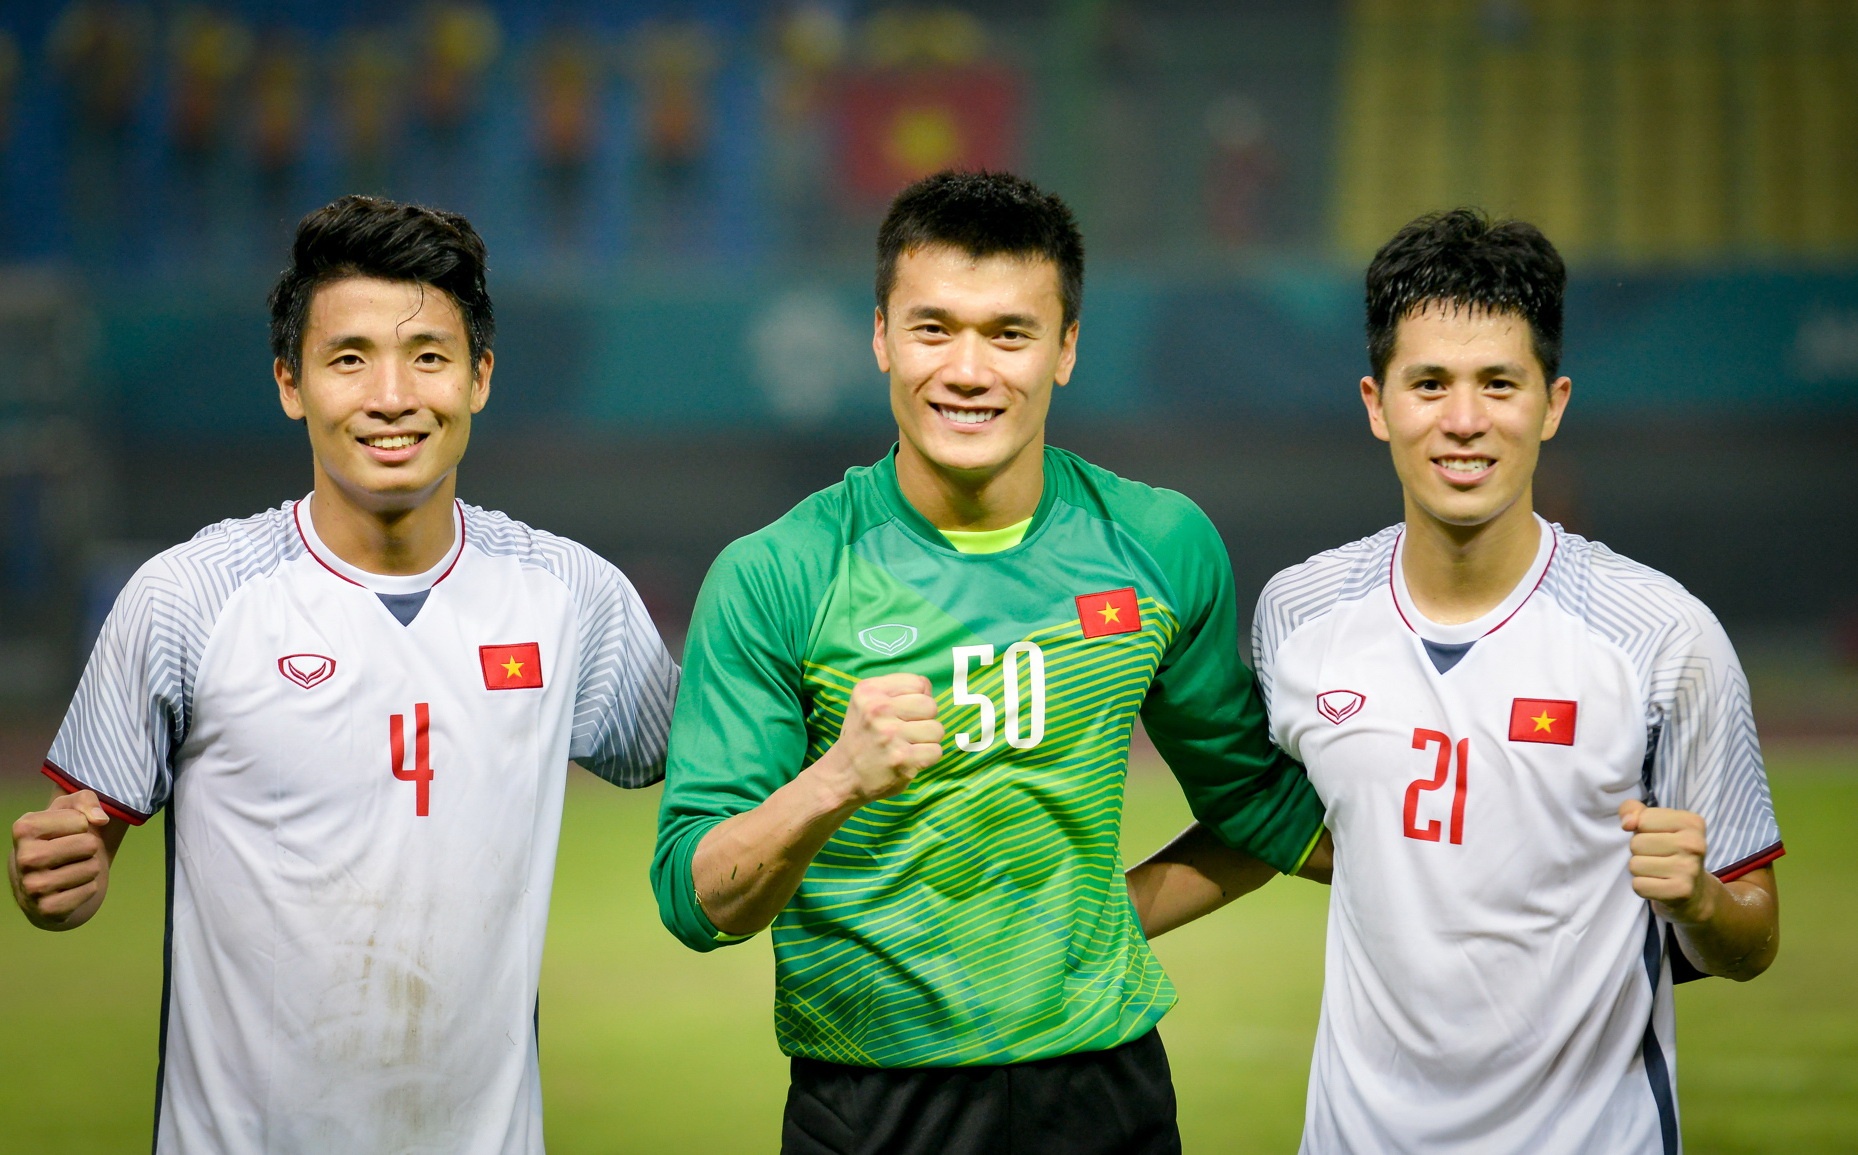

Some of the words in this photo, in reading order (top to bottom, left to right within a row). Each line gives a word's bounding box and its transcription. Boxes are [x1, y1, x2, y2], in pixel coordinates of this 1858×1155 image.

[951, 641, 1046, 753] 50
[389, 702, 434, 817] 4
[1403, 727, 1470, 846] 21
